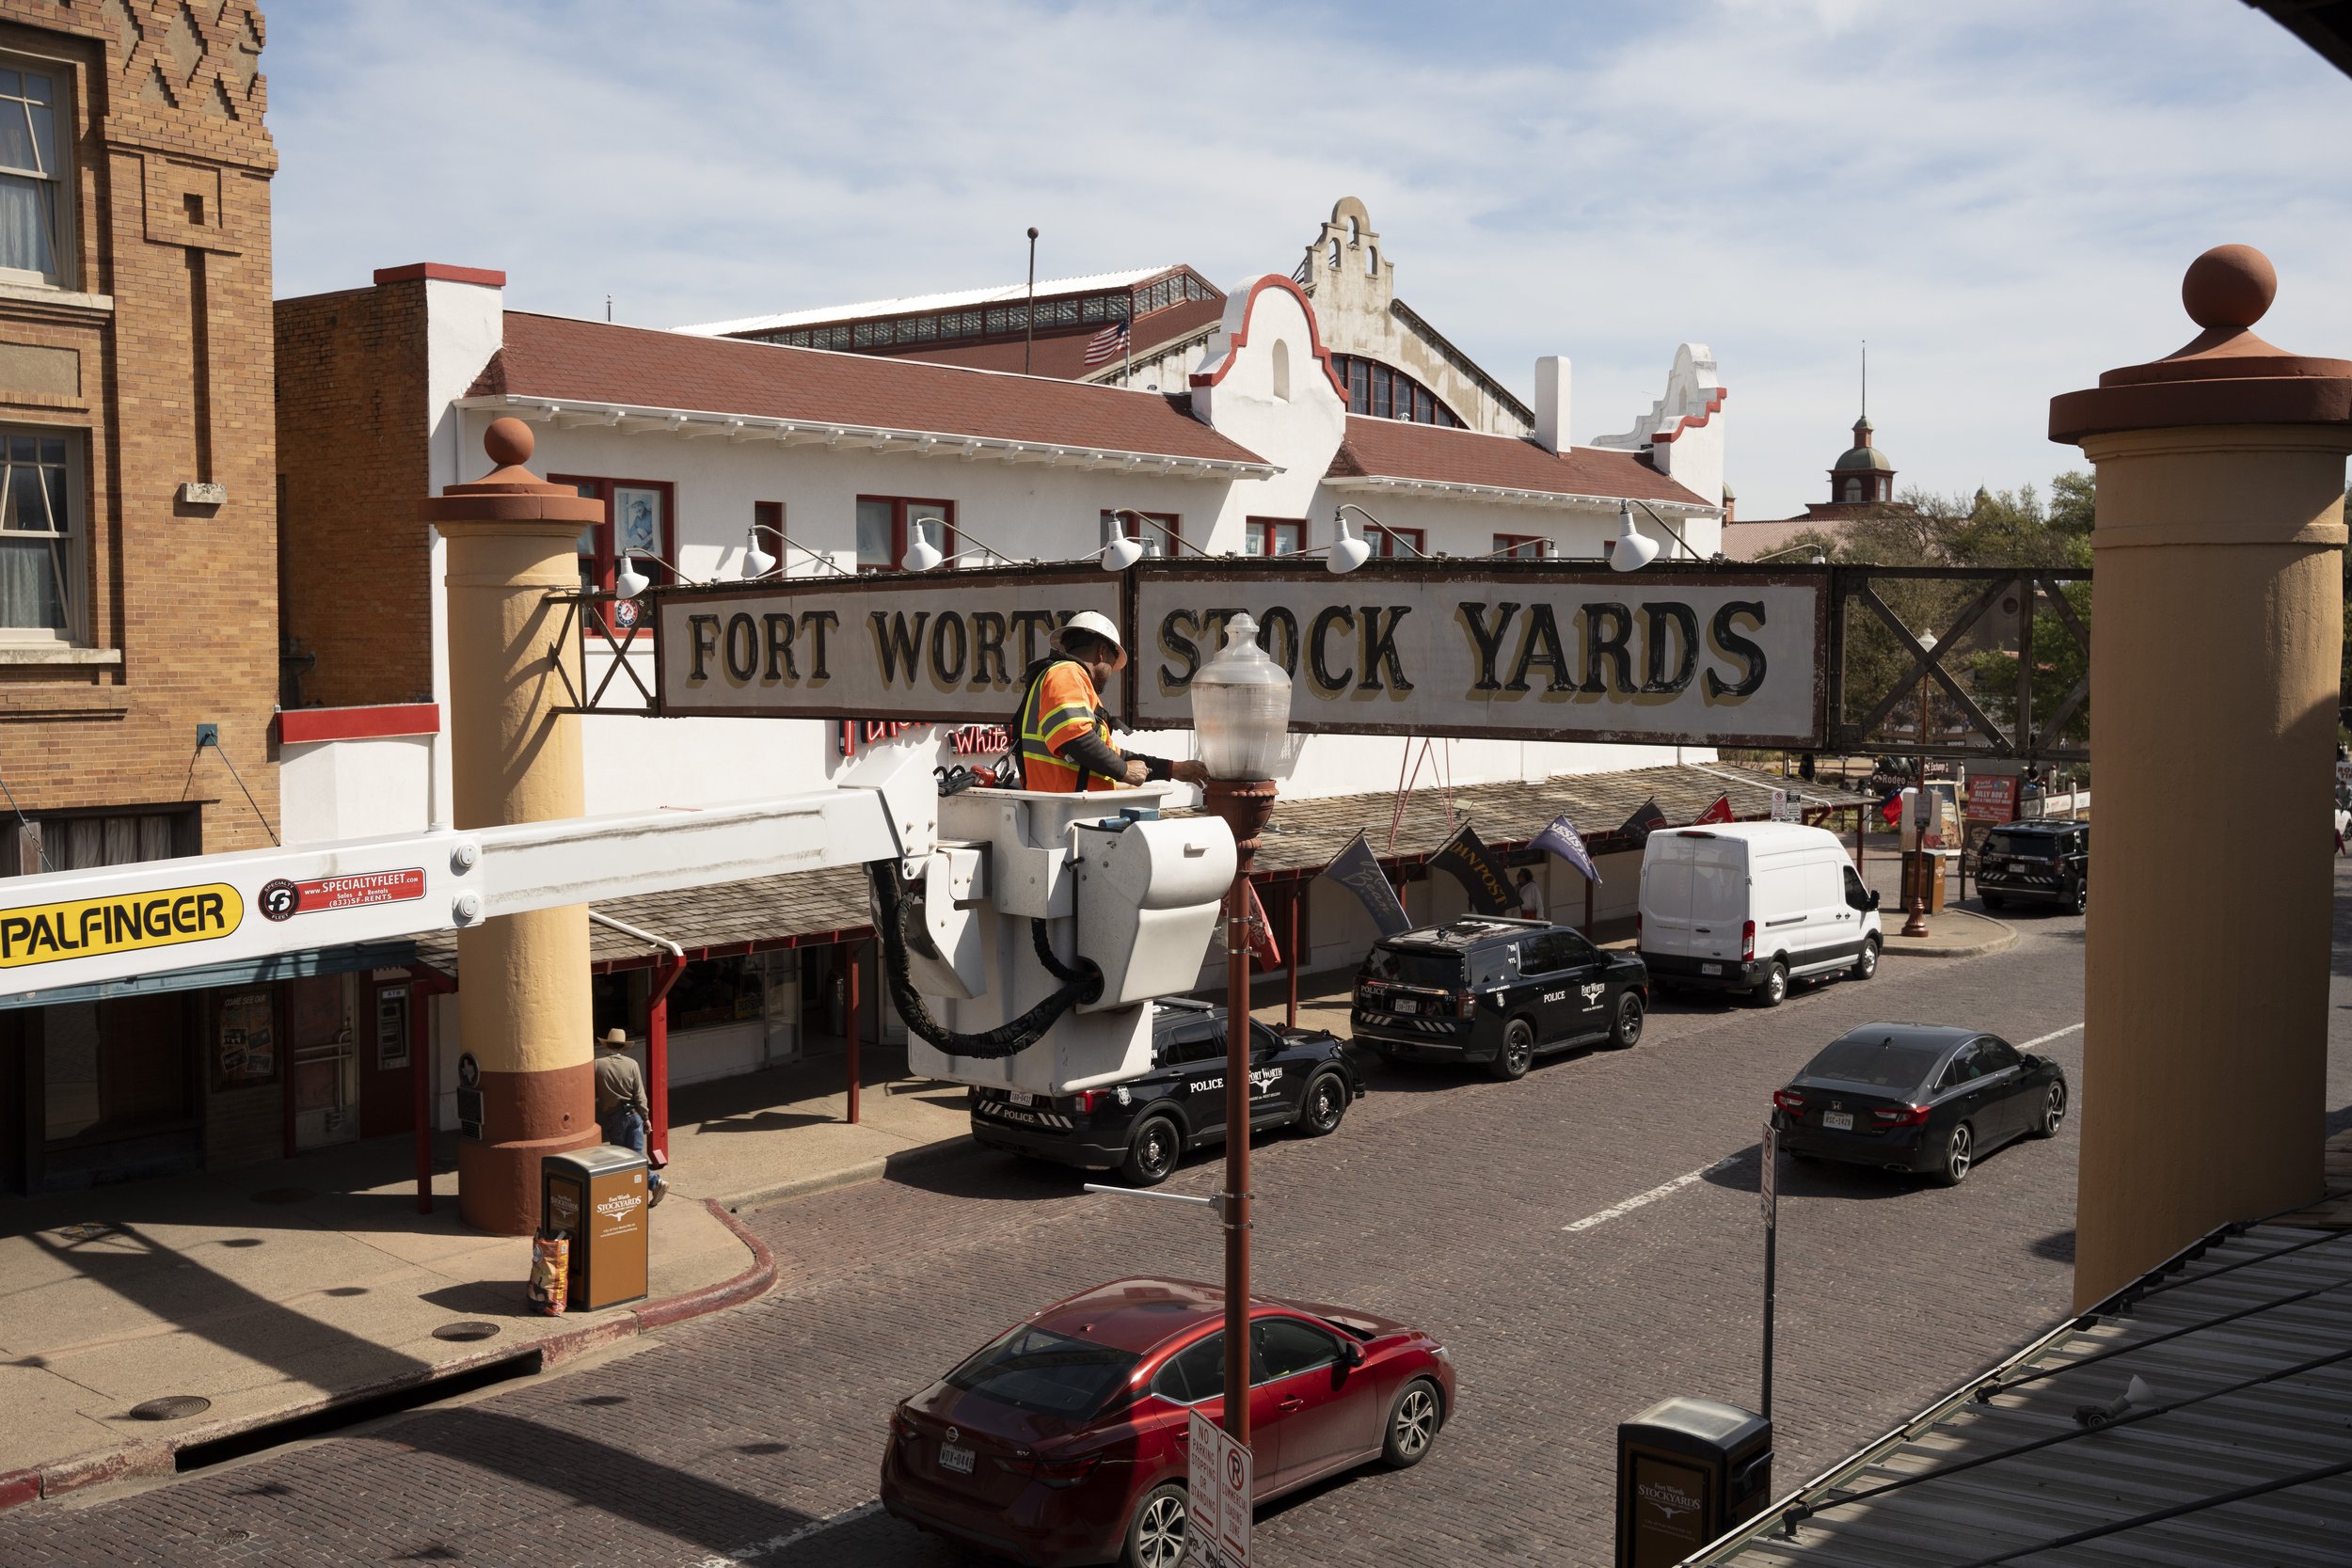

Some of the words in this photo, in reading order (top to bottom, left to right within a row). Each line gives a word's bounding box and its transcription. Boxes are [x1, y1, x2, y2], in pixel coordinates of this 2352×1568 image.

[686, 610, 840, 689] FORT
[867, 610, 1097, 694] WORT
[1454, 599, 1767, 705] YARDS
[955, 726, 1009, 754] White
[1883, 773, 1906, 784] Rodeo
[1449, 841, 1477, 872] DAN
[1474, 865, 1508, 905] POST
[264, 880, 294, 893] SPECIALTY
[329, 893, 392, 909] (833)SF-RENTS
[1, 892, 225, 959] PALFINGER
[225, 996, 242, 1007] COME
[242, 994, 254, 1004] SEE
[254, 993, 266, 1003] OUR
[1360, 985, 1386, 996] POLICE
[1543, 990, 1565, 1004] POLICE
[1249, 1070, 1262, 1082] FORT
[1262, 1067, 1283, 1080] WORTH
[1190, 1078, 1224, 1093] POLICE
[1004, 1109, 1035, 1123] POLICE
[596, 1196, 642, 1212] STOCKYARDS
[1198, 1423, 1209, 1445] NO
[1193, 1438, 1215, 1465] PARKING
[1191, 1452, 1216, 1482] STOPPING
[1200, 1475, 1208, 1492] OR
[1191, 1483, 1216, 1514] STANDING
[1222, 1482, 1248, 1514] COMMERCIAL
[1638, 1483, 1701, 1510] STOCKYARDS
[1225, 1502, 1243, 1527] LOADING
[1229, 1520, 1240, 1539] ZONE
